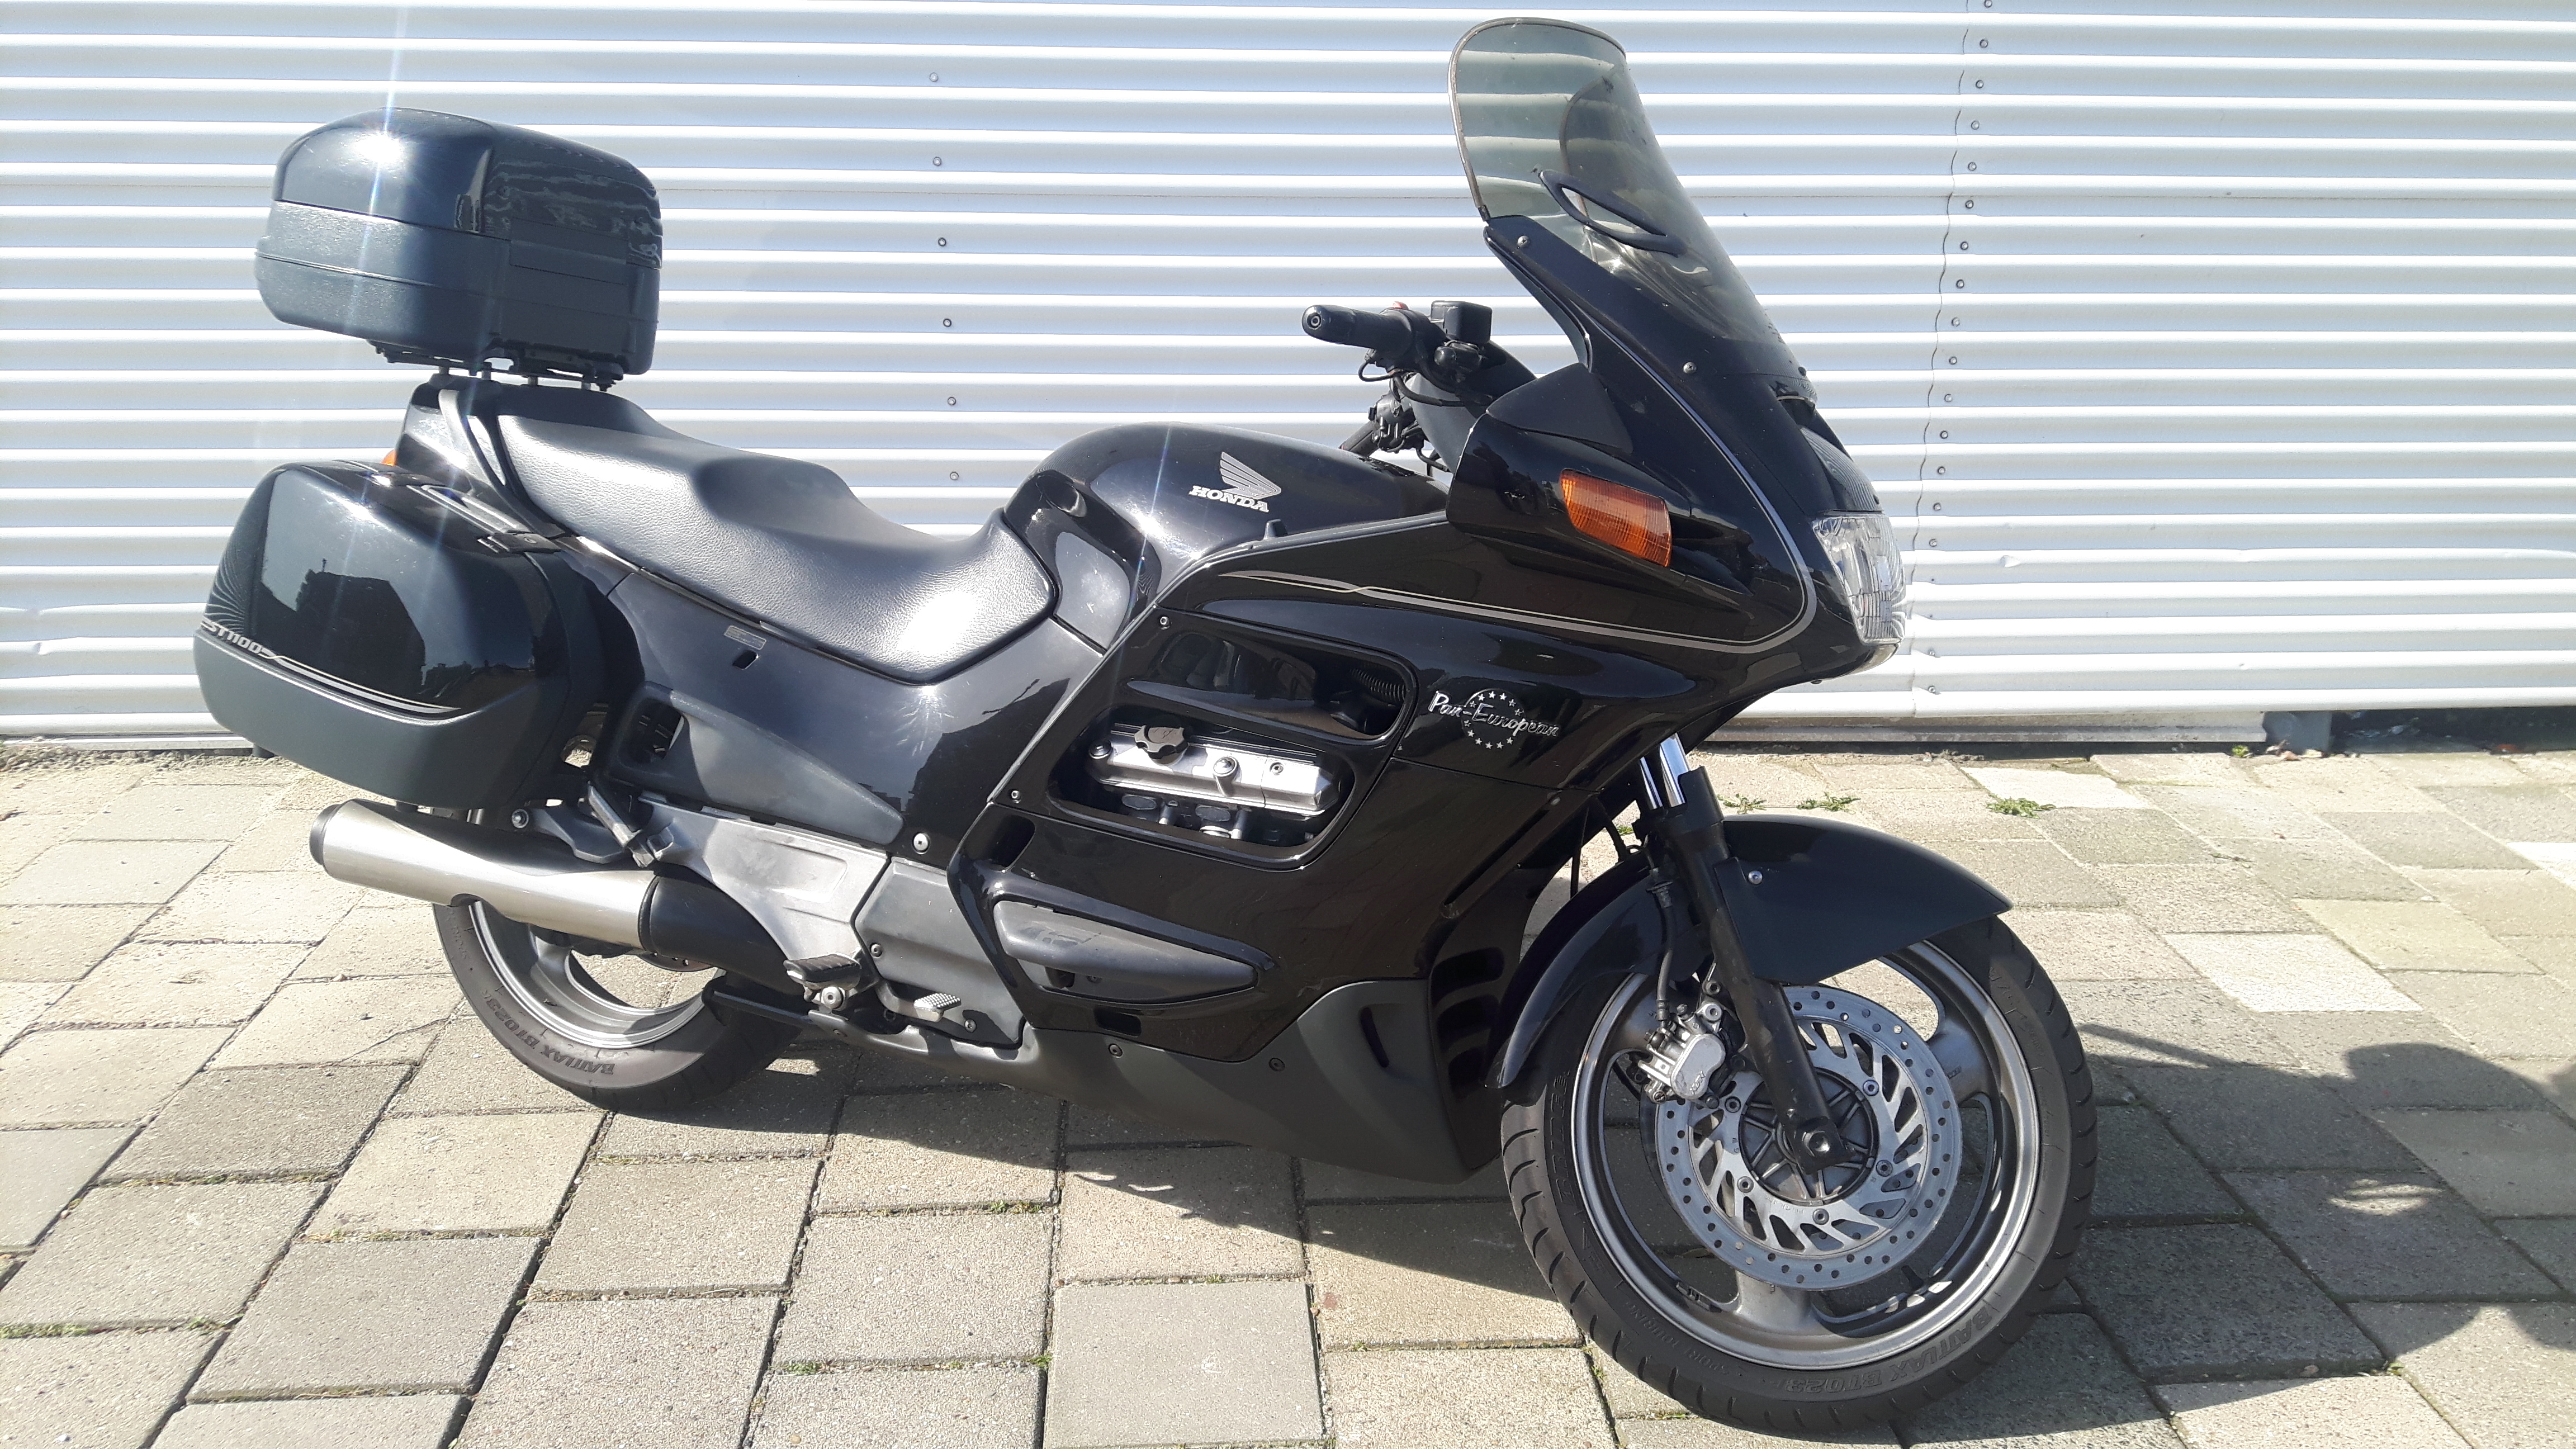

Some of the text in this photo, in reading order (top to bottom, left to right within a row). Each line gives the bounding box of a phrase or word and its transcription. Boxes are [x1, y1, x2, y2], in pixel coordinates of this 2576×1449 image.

[1189, 485, 1269, 513] HONDA
[207, 621, 263, 654] ST1100
[1428, 691, 1559, 737] Pan-European
[1888, 1306, 1992, 1381] BATTLAX
